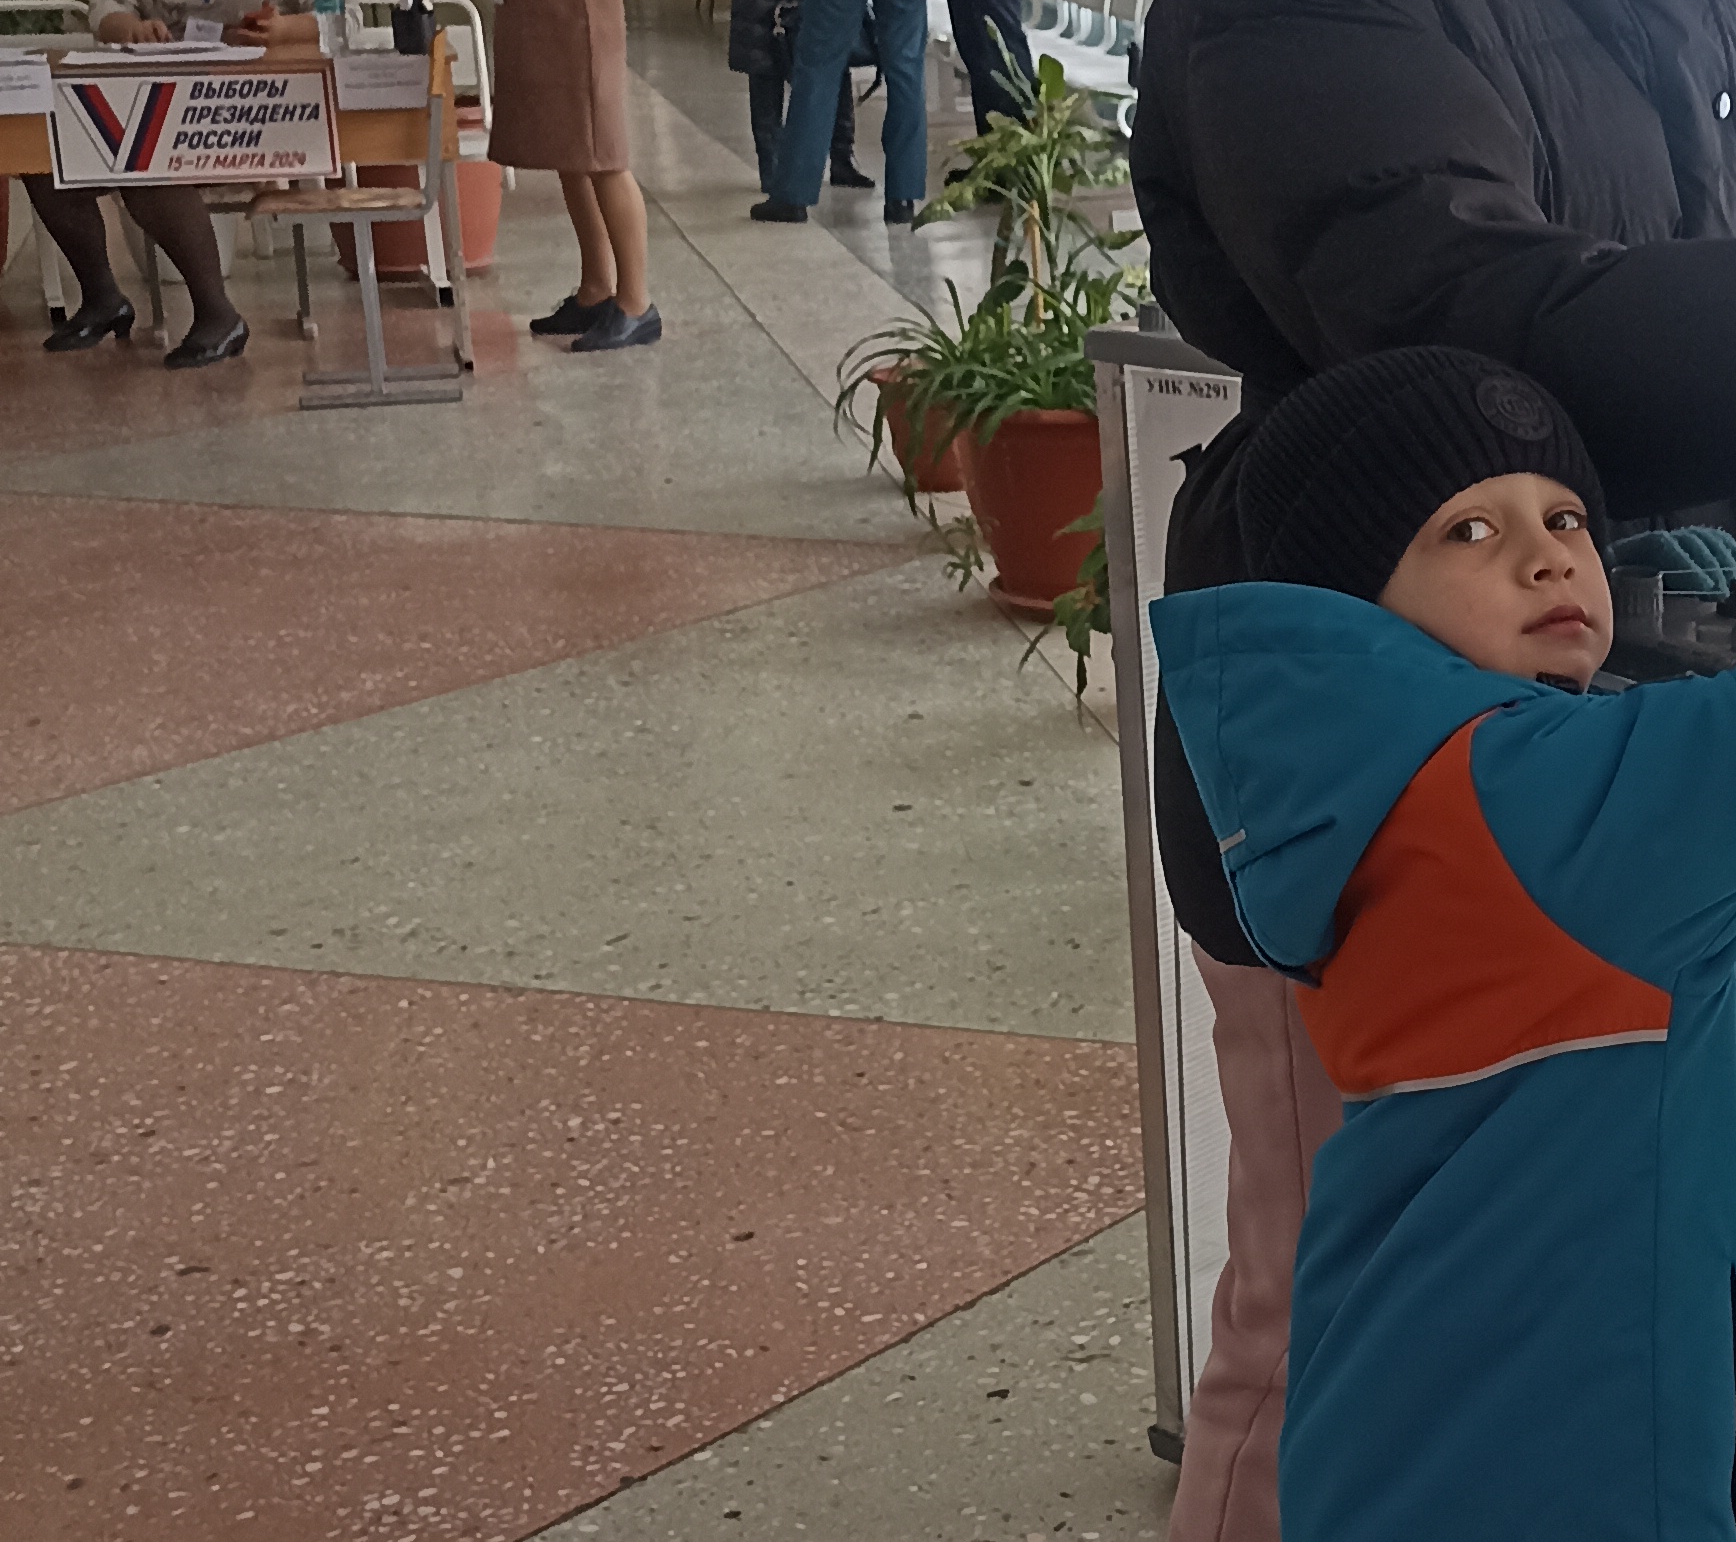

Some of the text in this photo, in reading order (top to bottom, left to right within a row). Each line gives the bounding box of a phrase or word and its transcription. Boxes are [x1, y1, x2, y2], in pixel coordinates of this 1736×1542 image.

[189, 78, 289, 100] ВЫБОРЫ
[181, 102, 321, 125] ПРЕЗИДЕНТА
[172, 128, 263, 150] РОССИИ
[212, 152, 266, 170] МАРТА
[269, 150, 307, 169] 2024
[1147, 378, 1183, 396] УИК
